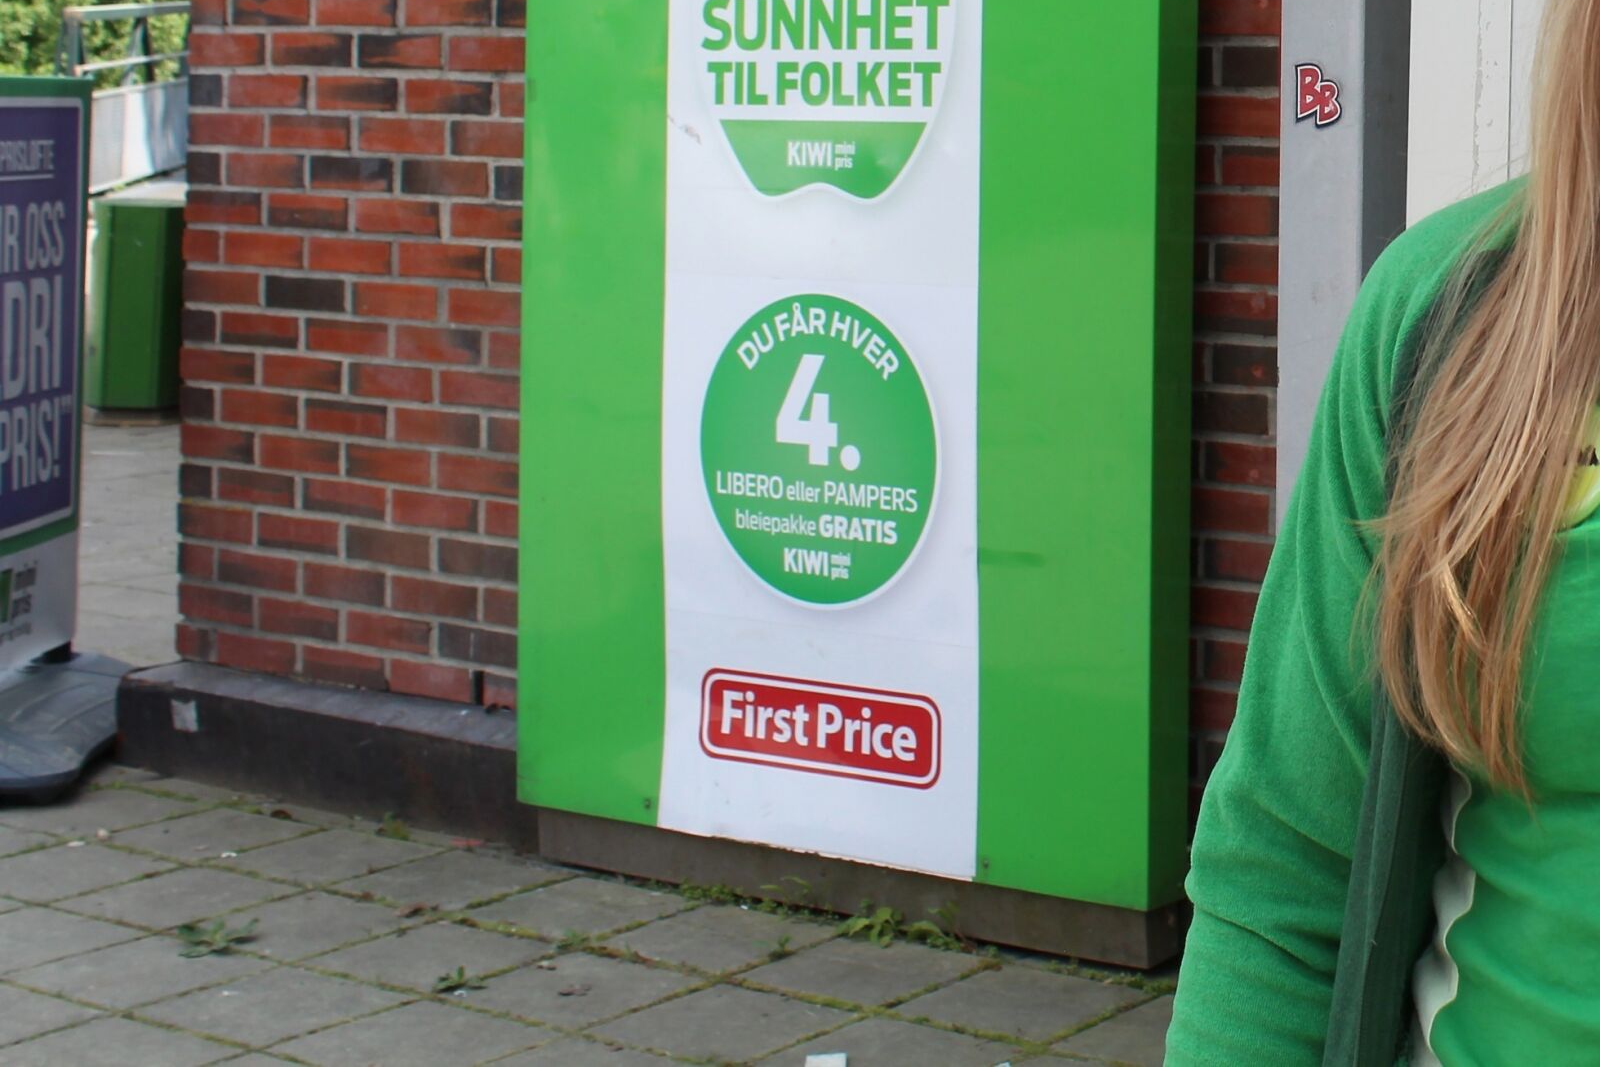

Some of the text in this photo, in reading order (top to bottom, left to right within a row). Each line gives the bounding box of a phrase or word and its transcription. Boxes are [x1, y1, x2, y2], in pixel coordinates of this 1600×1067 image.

[707, 61, 942, 108] TIL FOLKET
[787, 139, 856, 168] KIWI mini
[834, 154, 854, 171] pris
[25, 200, 65, 270] OSS
[735, 301, 900, 381] DU FÅR HVER
[775, 353, 862, 471] 4.
[716, 471, 919, 513] LIBERO eller PAMPERS
[735, 508, 898, 546] bleiepakke GRATIS
[783, 547, 829, 577] KIWI
[720, 689, 918, 762] First Price
